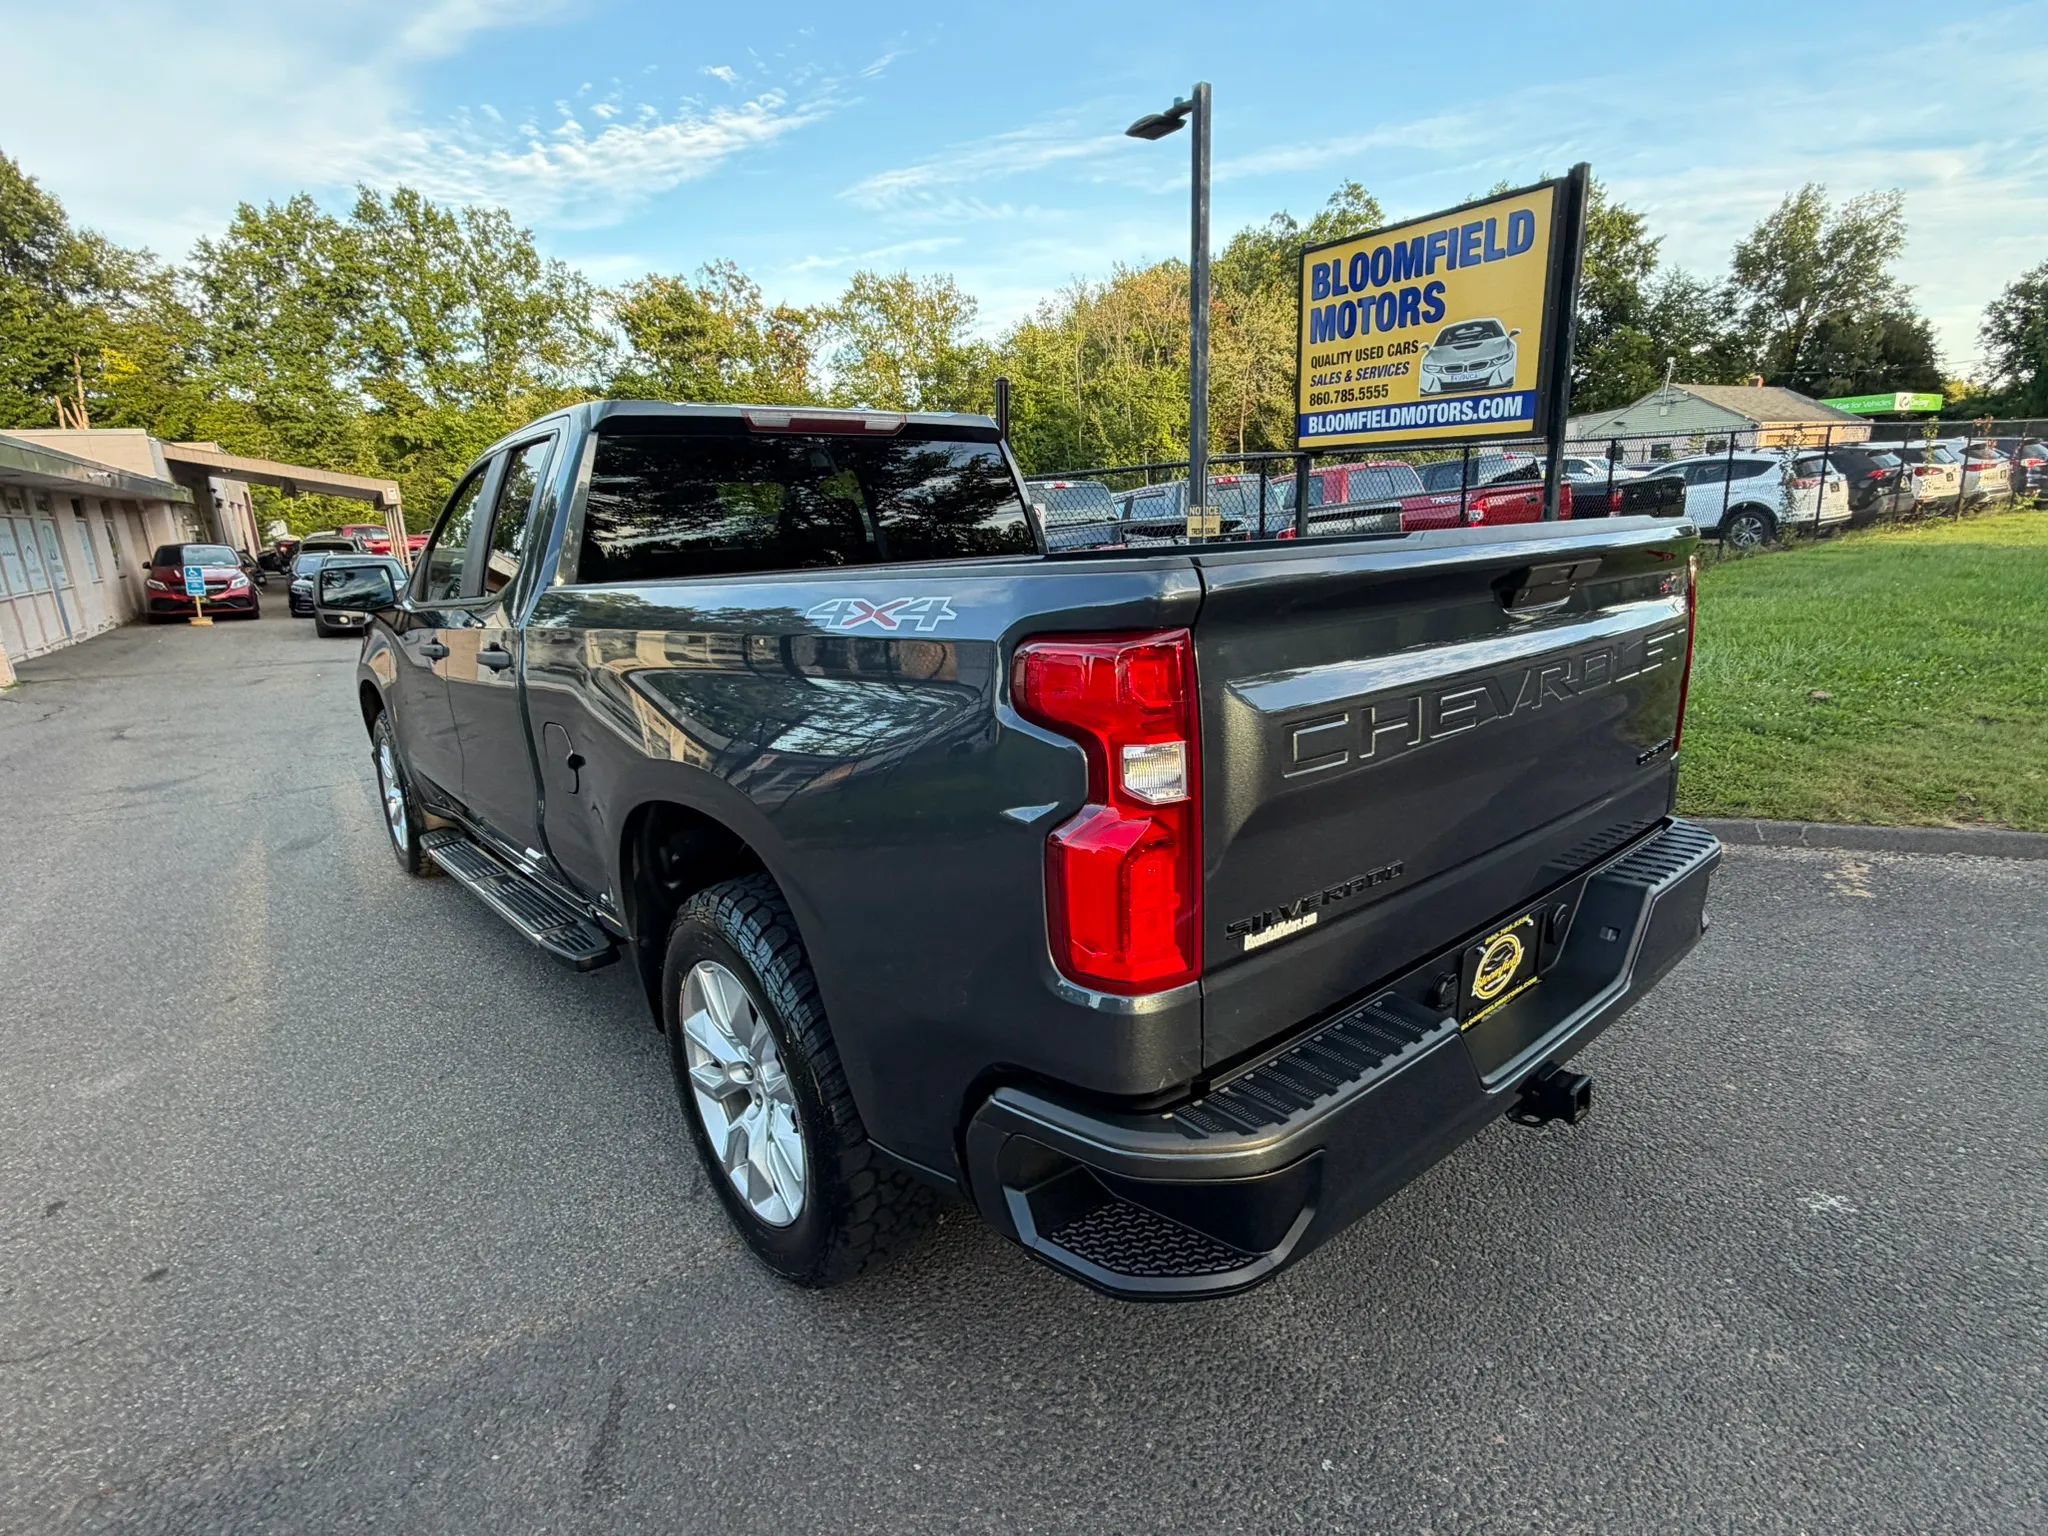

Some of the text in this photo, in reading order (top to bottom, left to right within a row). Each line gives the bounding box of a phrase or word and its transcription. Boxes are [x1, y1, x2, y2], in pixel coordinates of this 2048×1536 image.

[1311, 208, 1535, 301] BLOOMFIELD
[1309, 280, 1446, 345] MOTORS
[1311, 339, 1419, 369] QUALITY USED CARS
[1310, 361, 1410, 387] SALES & SERVICES
[1308, 395, 1523, 434] BLOOMFIELDMOTORS.COM
[1309, 384, 1389, 406] 860.785.5555
[1189, 506, 1220, 516] NOICE
[1281, 624, 1686, 779] CHEVROLET
[1225, 859, 1404, 940] SILVERADO
